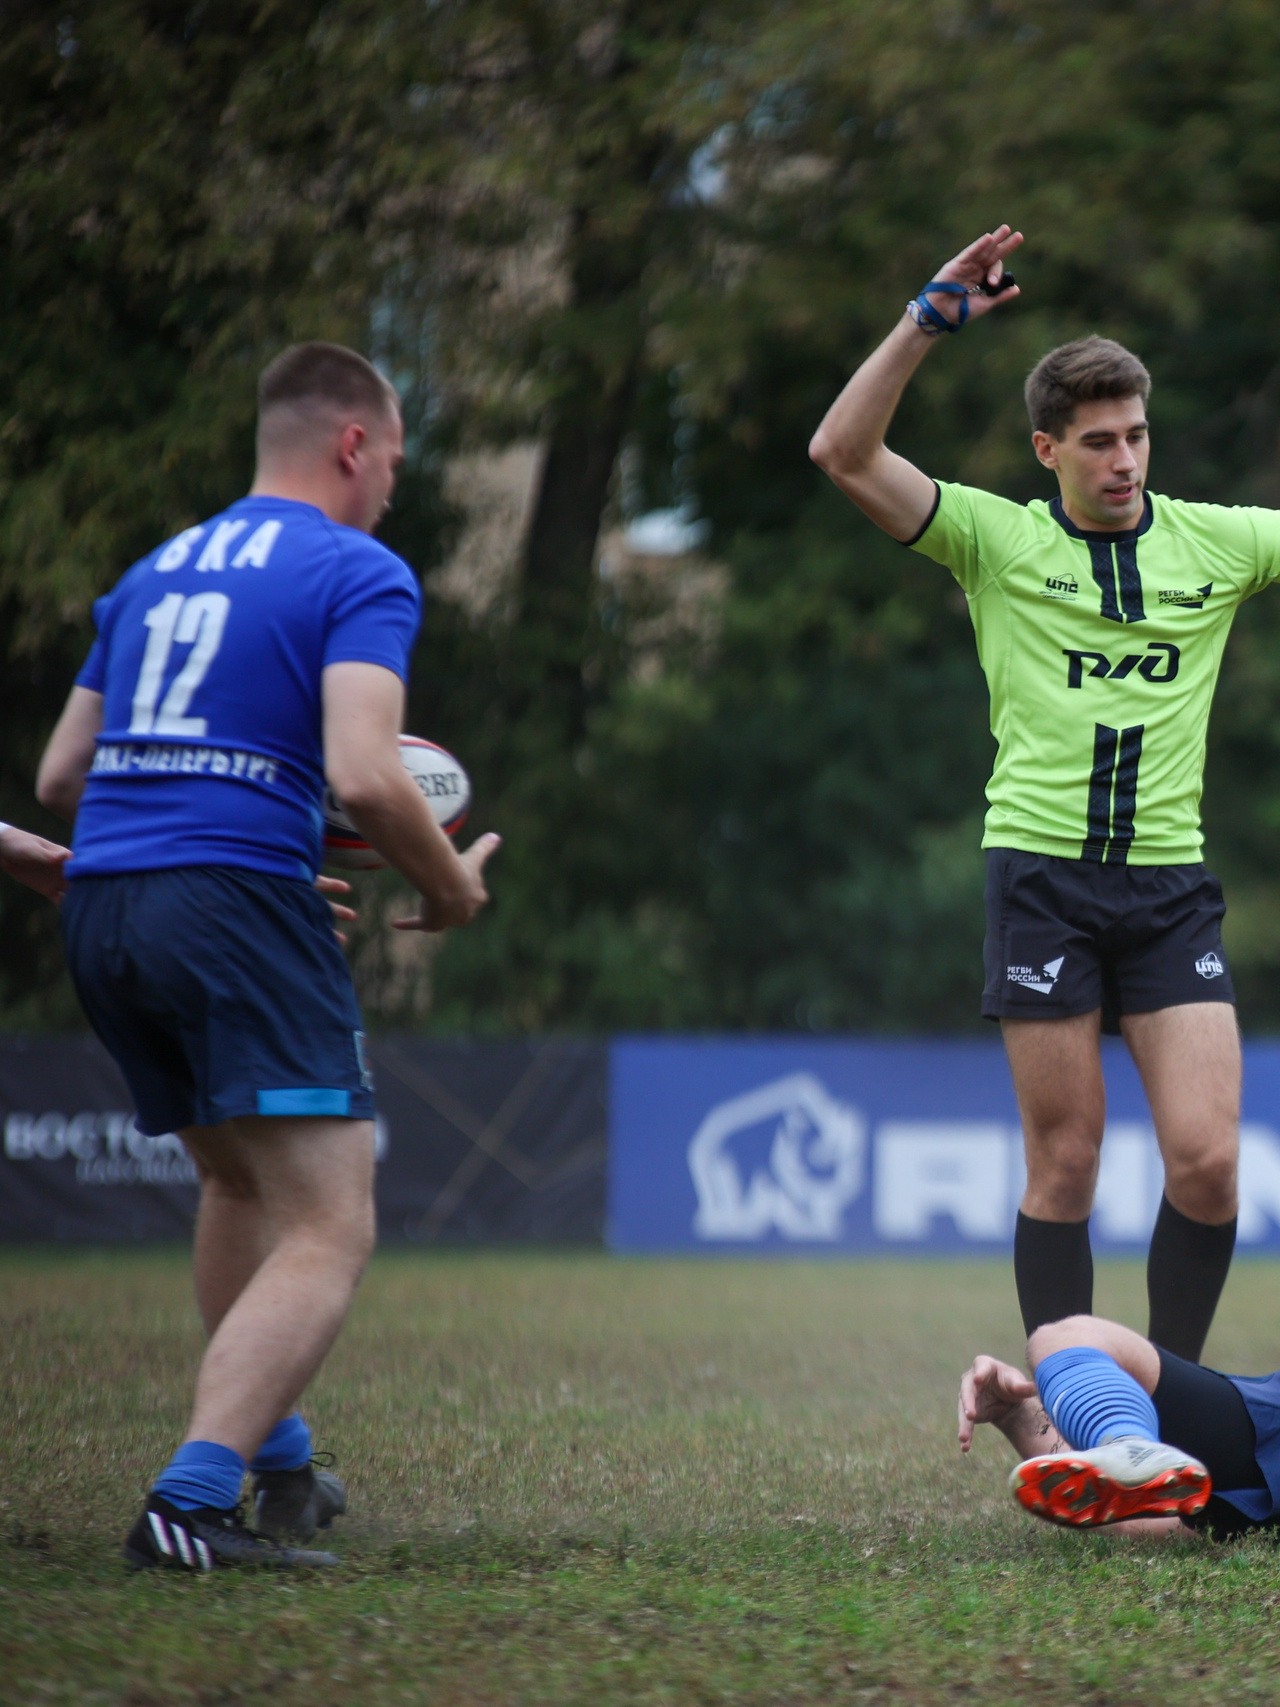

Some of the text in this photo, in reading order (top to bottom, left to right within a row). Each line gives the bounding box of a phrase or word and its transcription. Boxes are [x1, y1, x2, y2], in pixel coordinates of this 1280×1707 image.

[1158, 596, 1194, 605] РОССИИ
[128, 591, 231, 737] 12
[1007, 965, 1032, 975] РЕГБИ
[1007, 974, 1040, 982] РОССИИ
